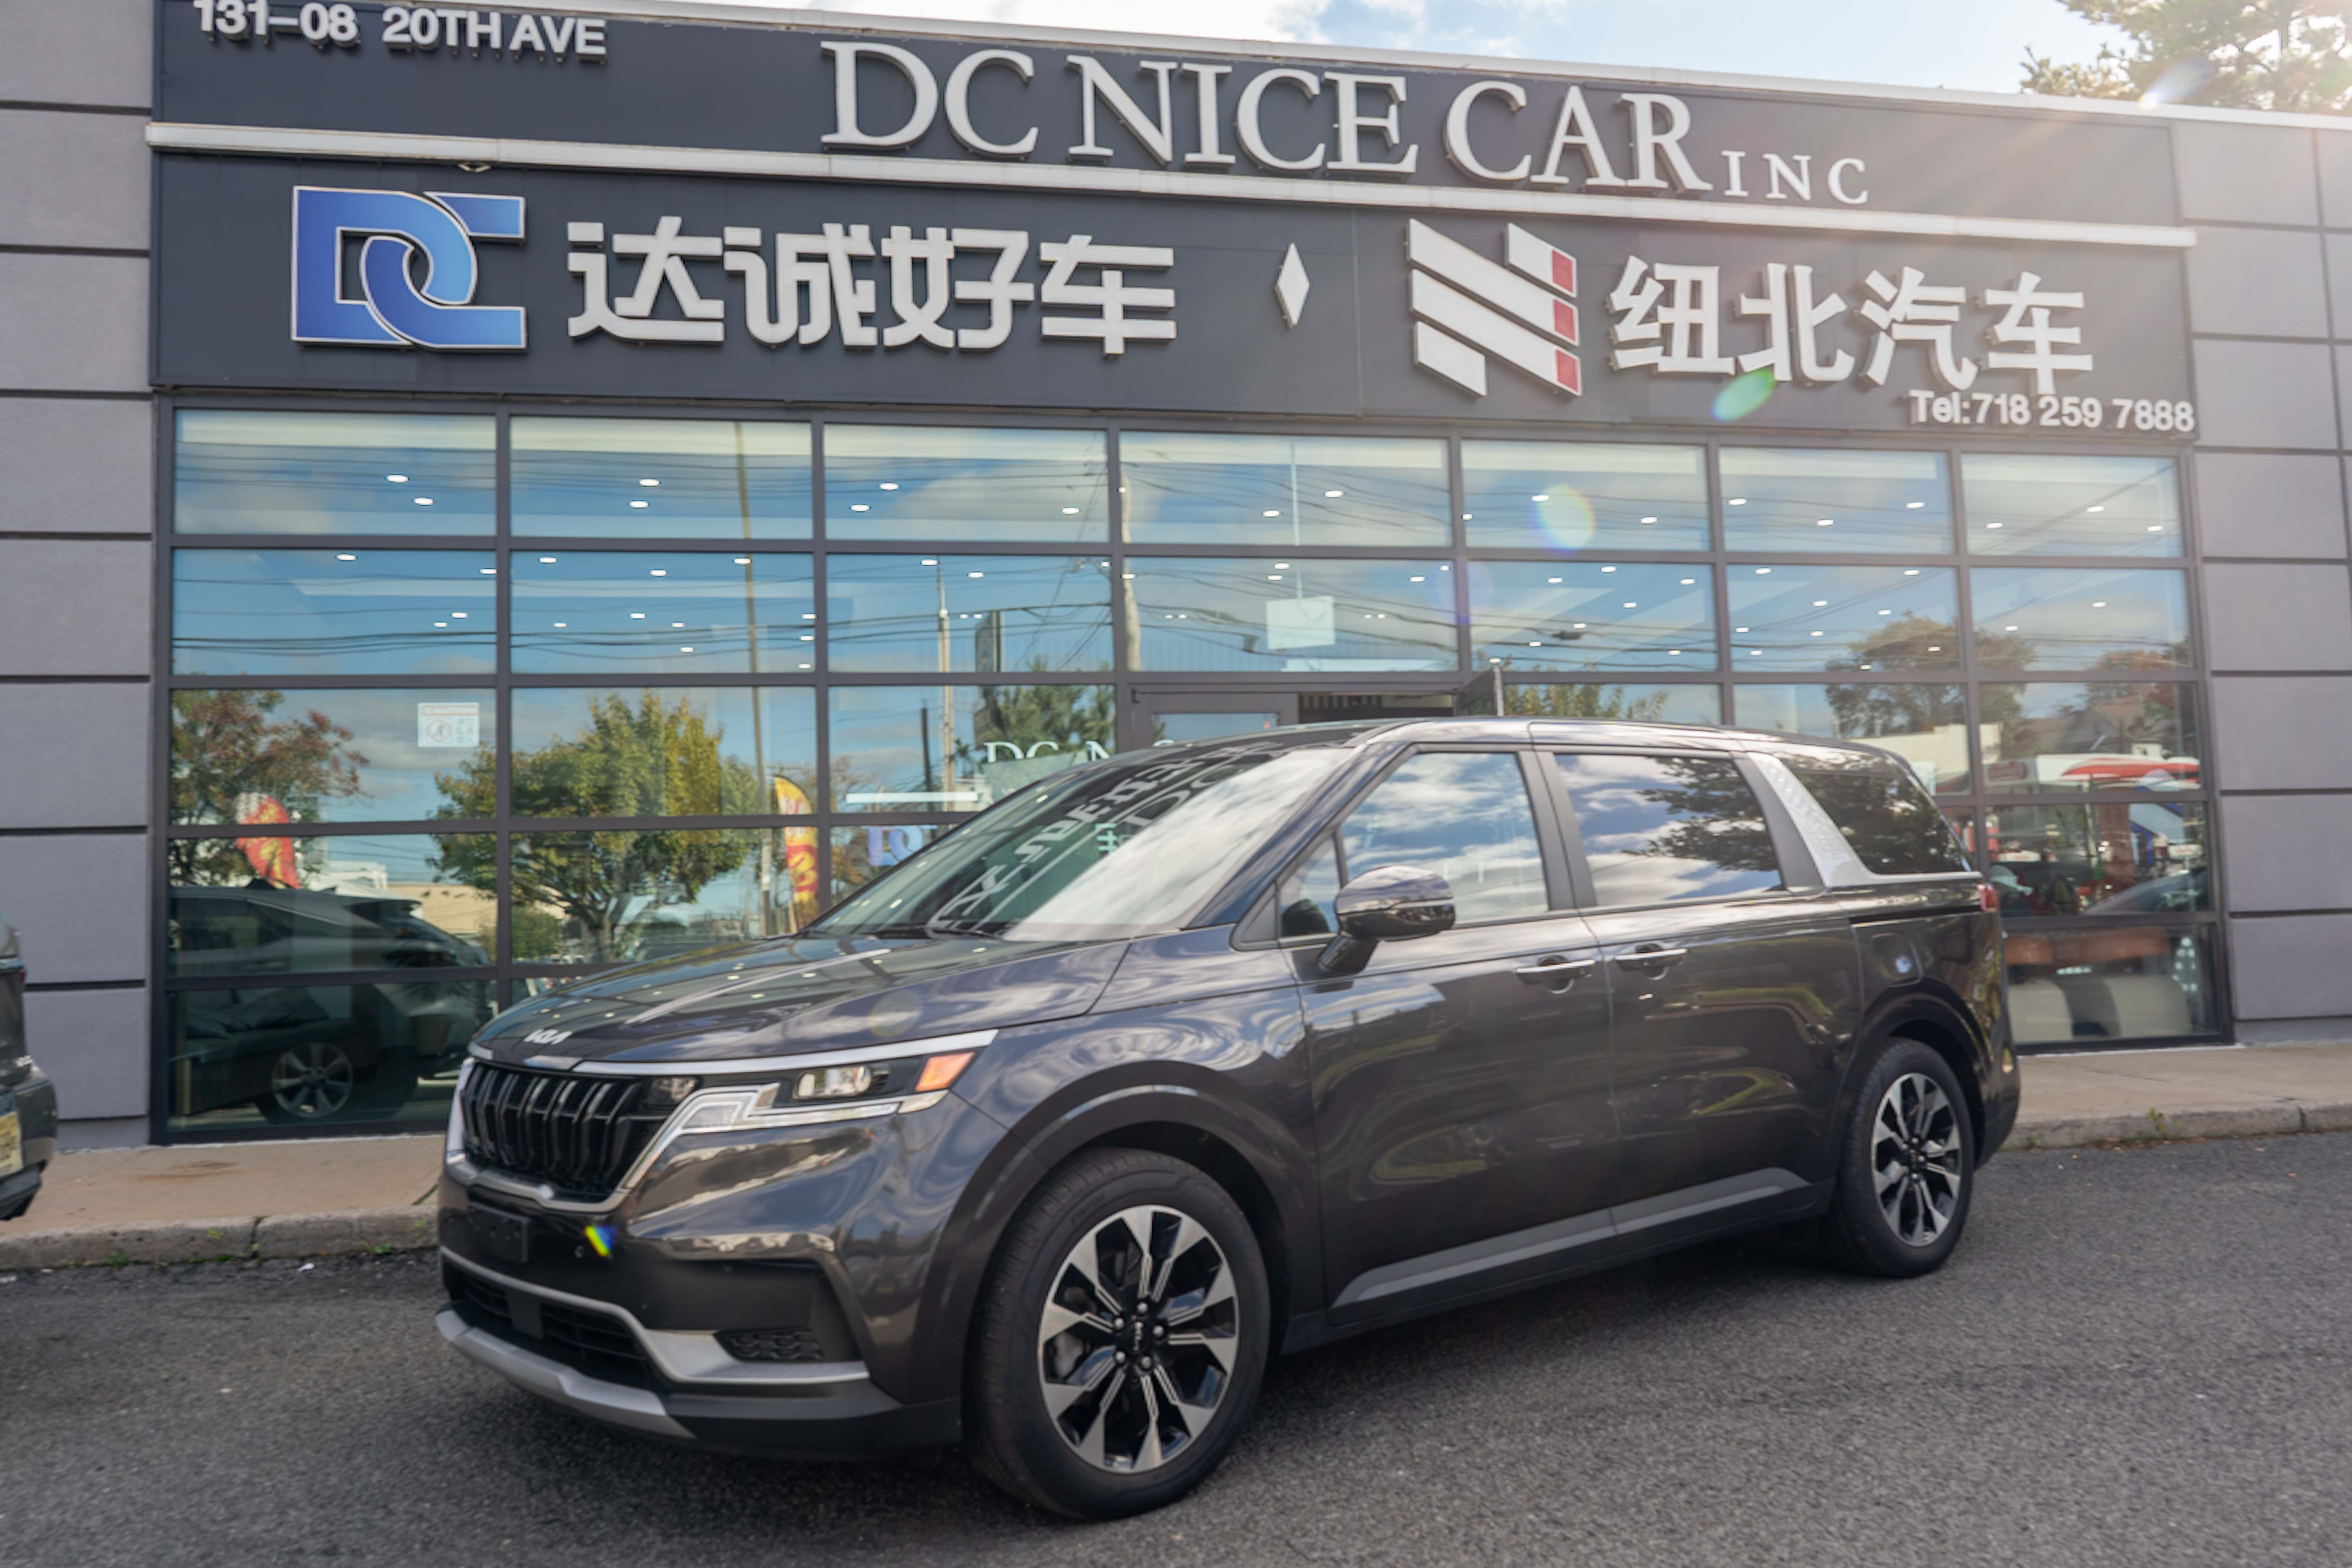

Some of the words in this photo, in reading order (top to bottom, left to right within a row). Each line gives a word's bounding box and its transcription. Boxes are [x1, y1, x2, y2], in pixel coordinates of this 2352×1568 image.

[193, 0, 358, 41] 131-08
[382, 7, 501, 49] 20TH
[509, 14, 606, 55] AVE
[820, 41, 1039, 156] DC
[1066, 55, 1418, 173] NICE
[1444, 80, 1713, 192] CAR
[1721, 150, 1869, 204] INC
[290, 185, 527, 350] DC
[568, 216, 1177, 356] 达诚好车
[1608, 255, 2093, 395] 纽北汽车
[2038, 396, 2103, 428] 259
[2112, 398, 2195, 432] 7888
